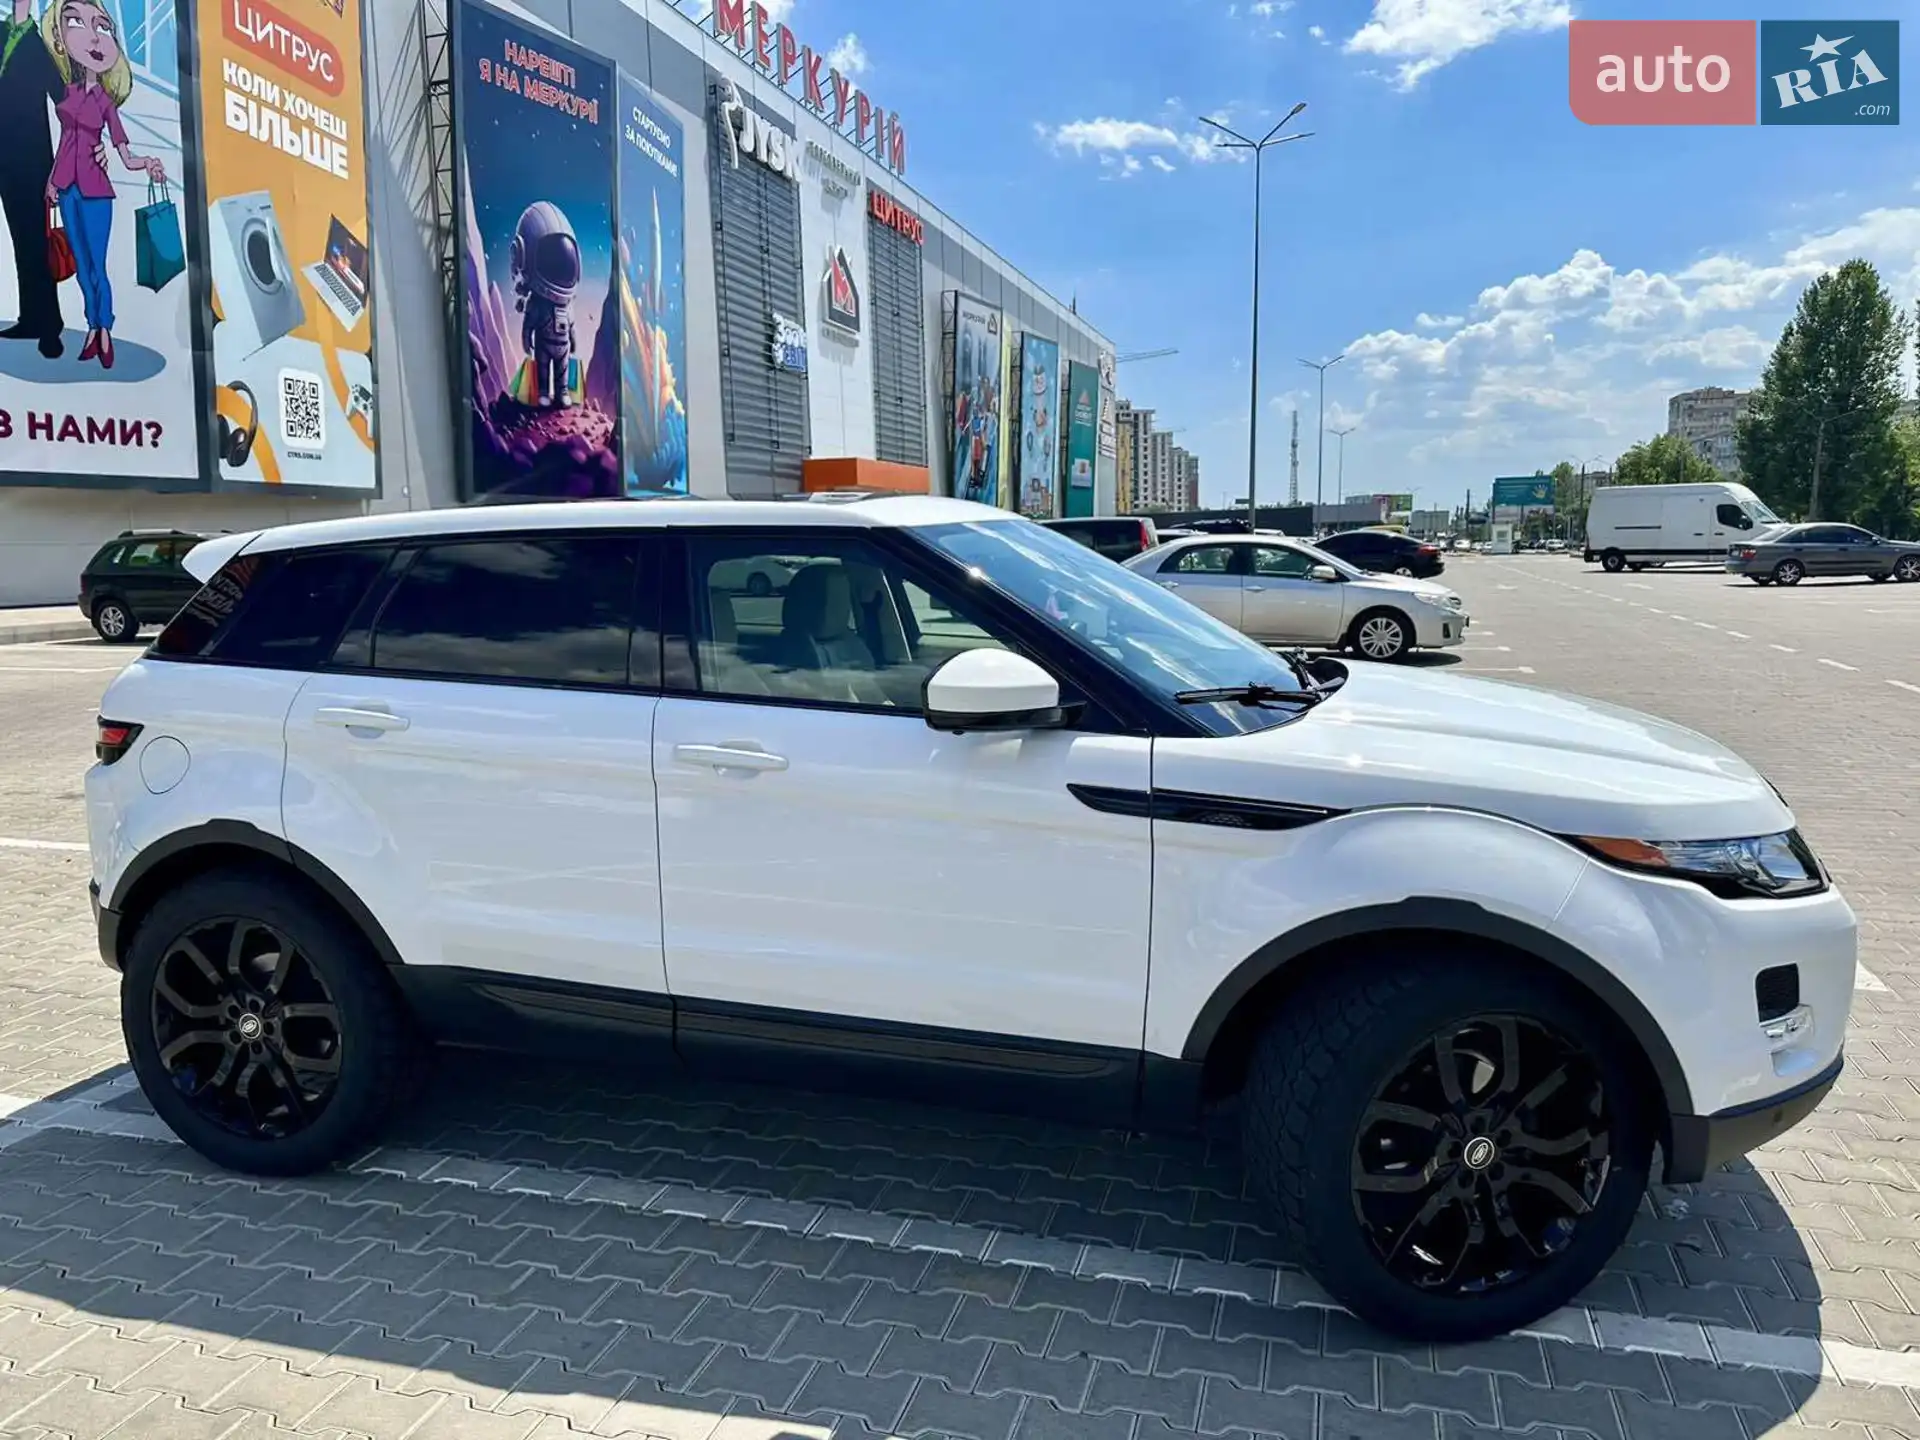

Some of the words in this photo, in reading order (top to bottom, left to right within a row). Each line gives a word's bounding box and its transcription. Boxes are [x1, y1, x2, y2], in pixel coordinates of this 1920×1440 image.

[233, 0, 335, 82] ЦИТРУС
[504, 39, 576, 88] НАРЕШТІ
[223, 58, 281, 106] КОЛИ
[282, 85, 348, 140] ХОЧЕШ
[478, 59, 492, 82] Я
[495, 63, 521, 94] НА
[713, 0, 905, 175] МЕРКУРІЙ
[223, 87, 349, 180] БІЛЬШЕ
[624, 124, 637, 144] ЗА
[739, 106, 804, 182] JYSK
[869, 190, 924, 245] ЦИТРУС
[27, 411, 163, 448] НАМИ?
